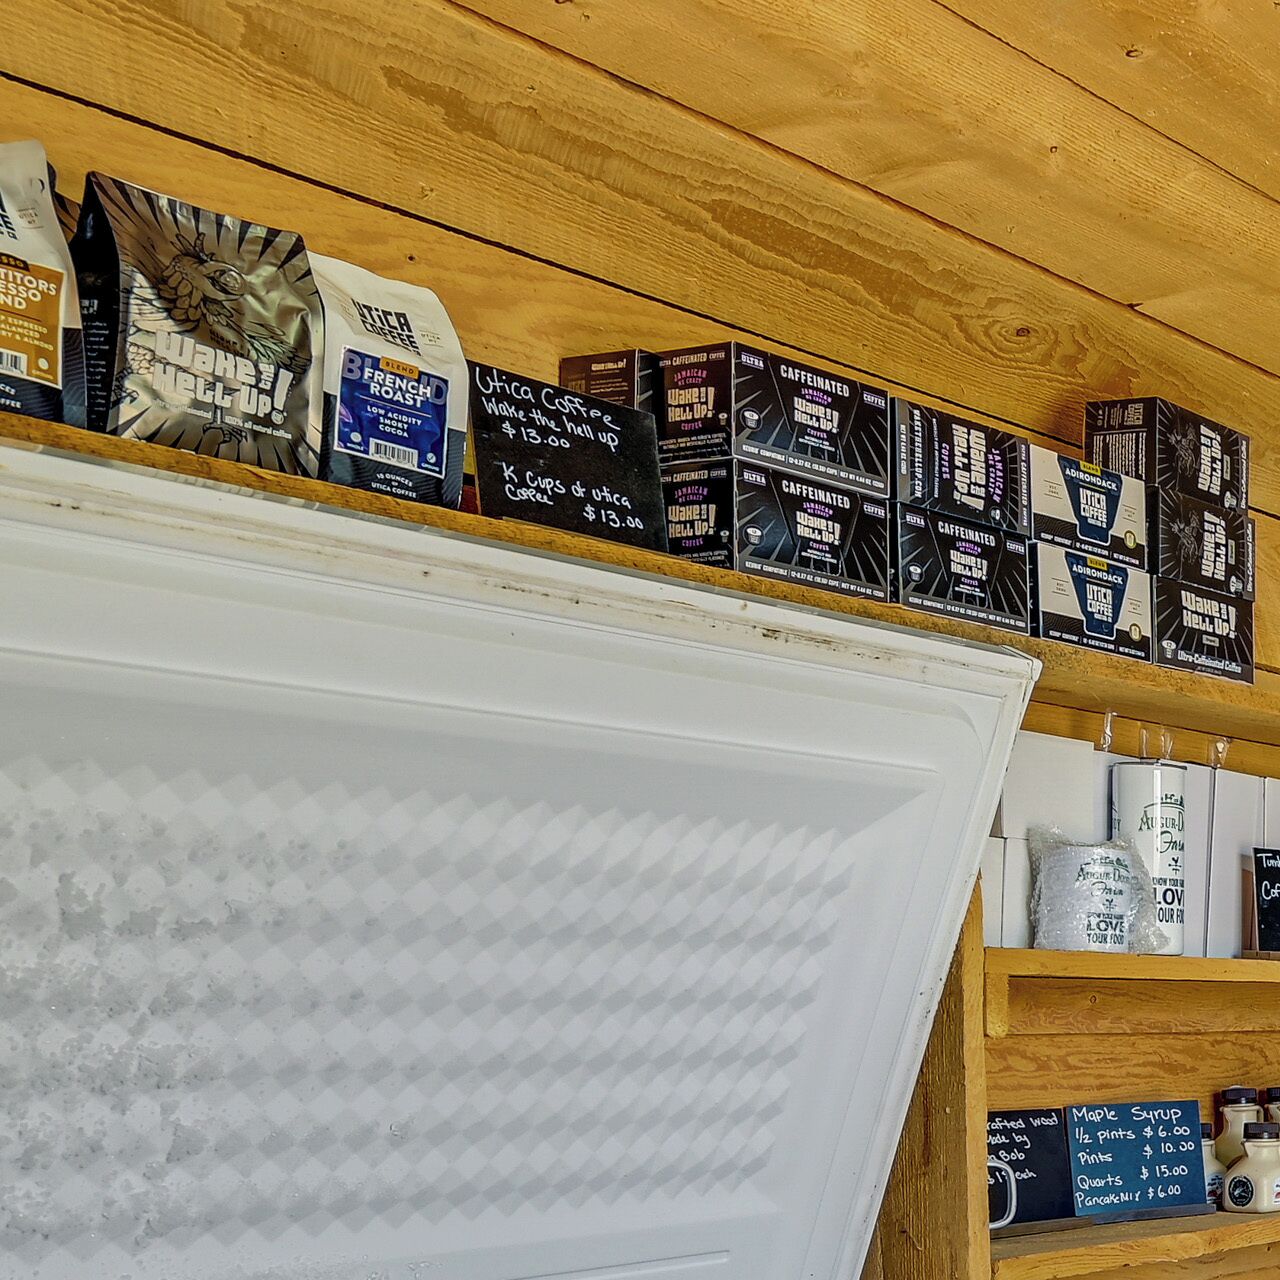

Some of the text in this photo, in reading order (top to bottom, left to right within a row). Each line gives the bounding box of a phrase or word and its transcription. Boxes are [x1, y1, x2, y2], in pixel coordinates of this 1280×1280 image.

[360, 318, 420, 352] COFFEE
[384, 360, 415, 375] BLEND
[672, 352, 707, 366] CAFFEINATED
[741, 354, 764, 369] ULTRA
[364, 367, 431, 398] FRENCH
[780, 364, 850, 397] CAFFEINATED
[370, 383, 424, 408] ROAST
[475, 366, 621, 431] Utica Coffee
[864, 393, 886, 407] COFFEE
[367, 405, 422, 426] LOW ACIDITY
[379, 417, 408, 430] SMOKY
[482, 396, 619, 452] Wake the hell up
[379, 424, 409, 438] COCOA
[941, 442, 950, 480] COFFEE
[385, 473, 413, 488] OUNCES
[502, 461, 518, 483] K
[525, 471, 566, 496] Cups
[673, 470, 709, 483] CAFFEINATED
[743, 471, 766, 486] ULTRA
[1065, 467, 1118, 491] ADIRONDACK
[371, 481, 417, 499] UTICA COFFEE
[782, 480, 850, 509] CAFFEINATED
[864, 504, 886, 517] COFFEE
[1080, 504, 1108, 523] COFFEE
[905, 514, 925, 527] ULTRA
[938, 521, 996, 547] CAFFEINATED
[1006, 541, 1025, 553] COFFEE
[1072, 564, 1124, 585] ADIRONDACK
[1086, 599, 1113, 618] COFFEE
[1086, 919, 1125, 934] LOVE
[1087, 932, 1108, 944] YOUR
[1072, 1107, 1182, 1124] Maple Syrup
[1013, 1132, 1031, 1149] by
[1075, 1127, 1092, 1144] 1/2
[1097, 1128, 1136, 1144] pints
[1158, 1126, 1190, 1137] 6.00
[1000, 1149, 1025, 1162] Bob
[1077, 1149, 1113, 1165] Pints
[1077, 1174, 1123, 1190] Quarts
[1156, 1166, 1188, 1178] 15.00
